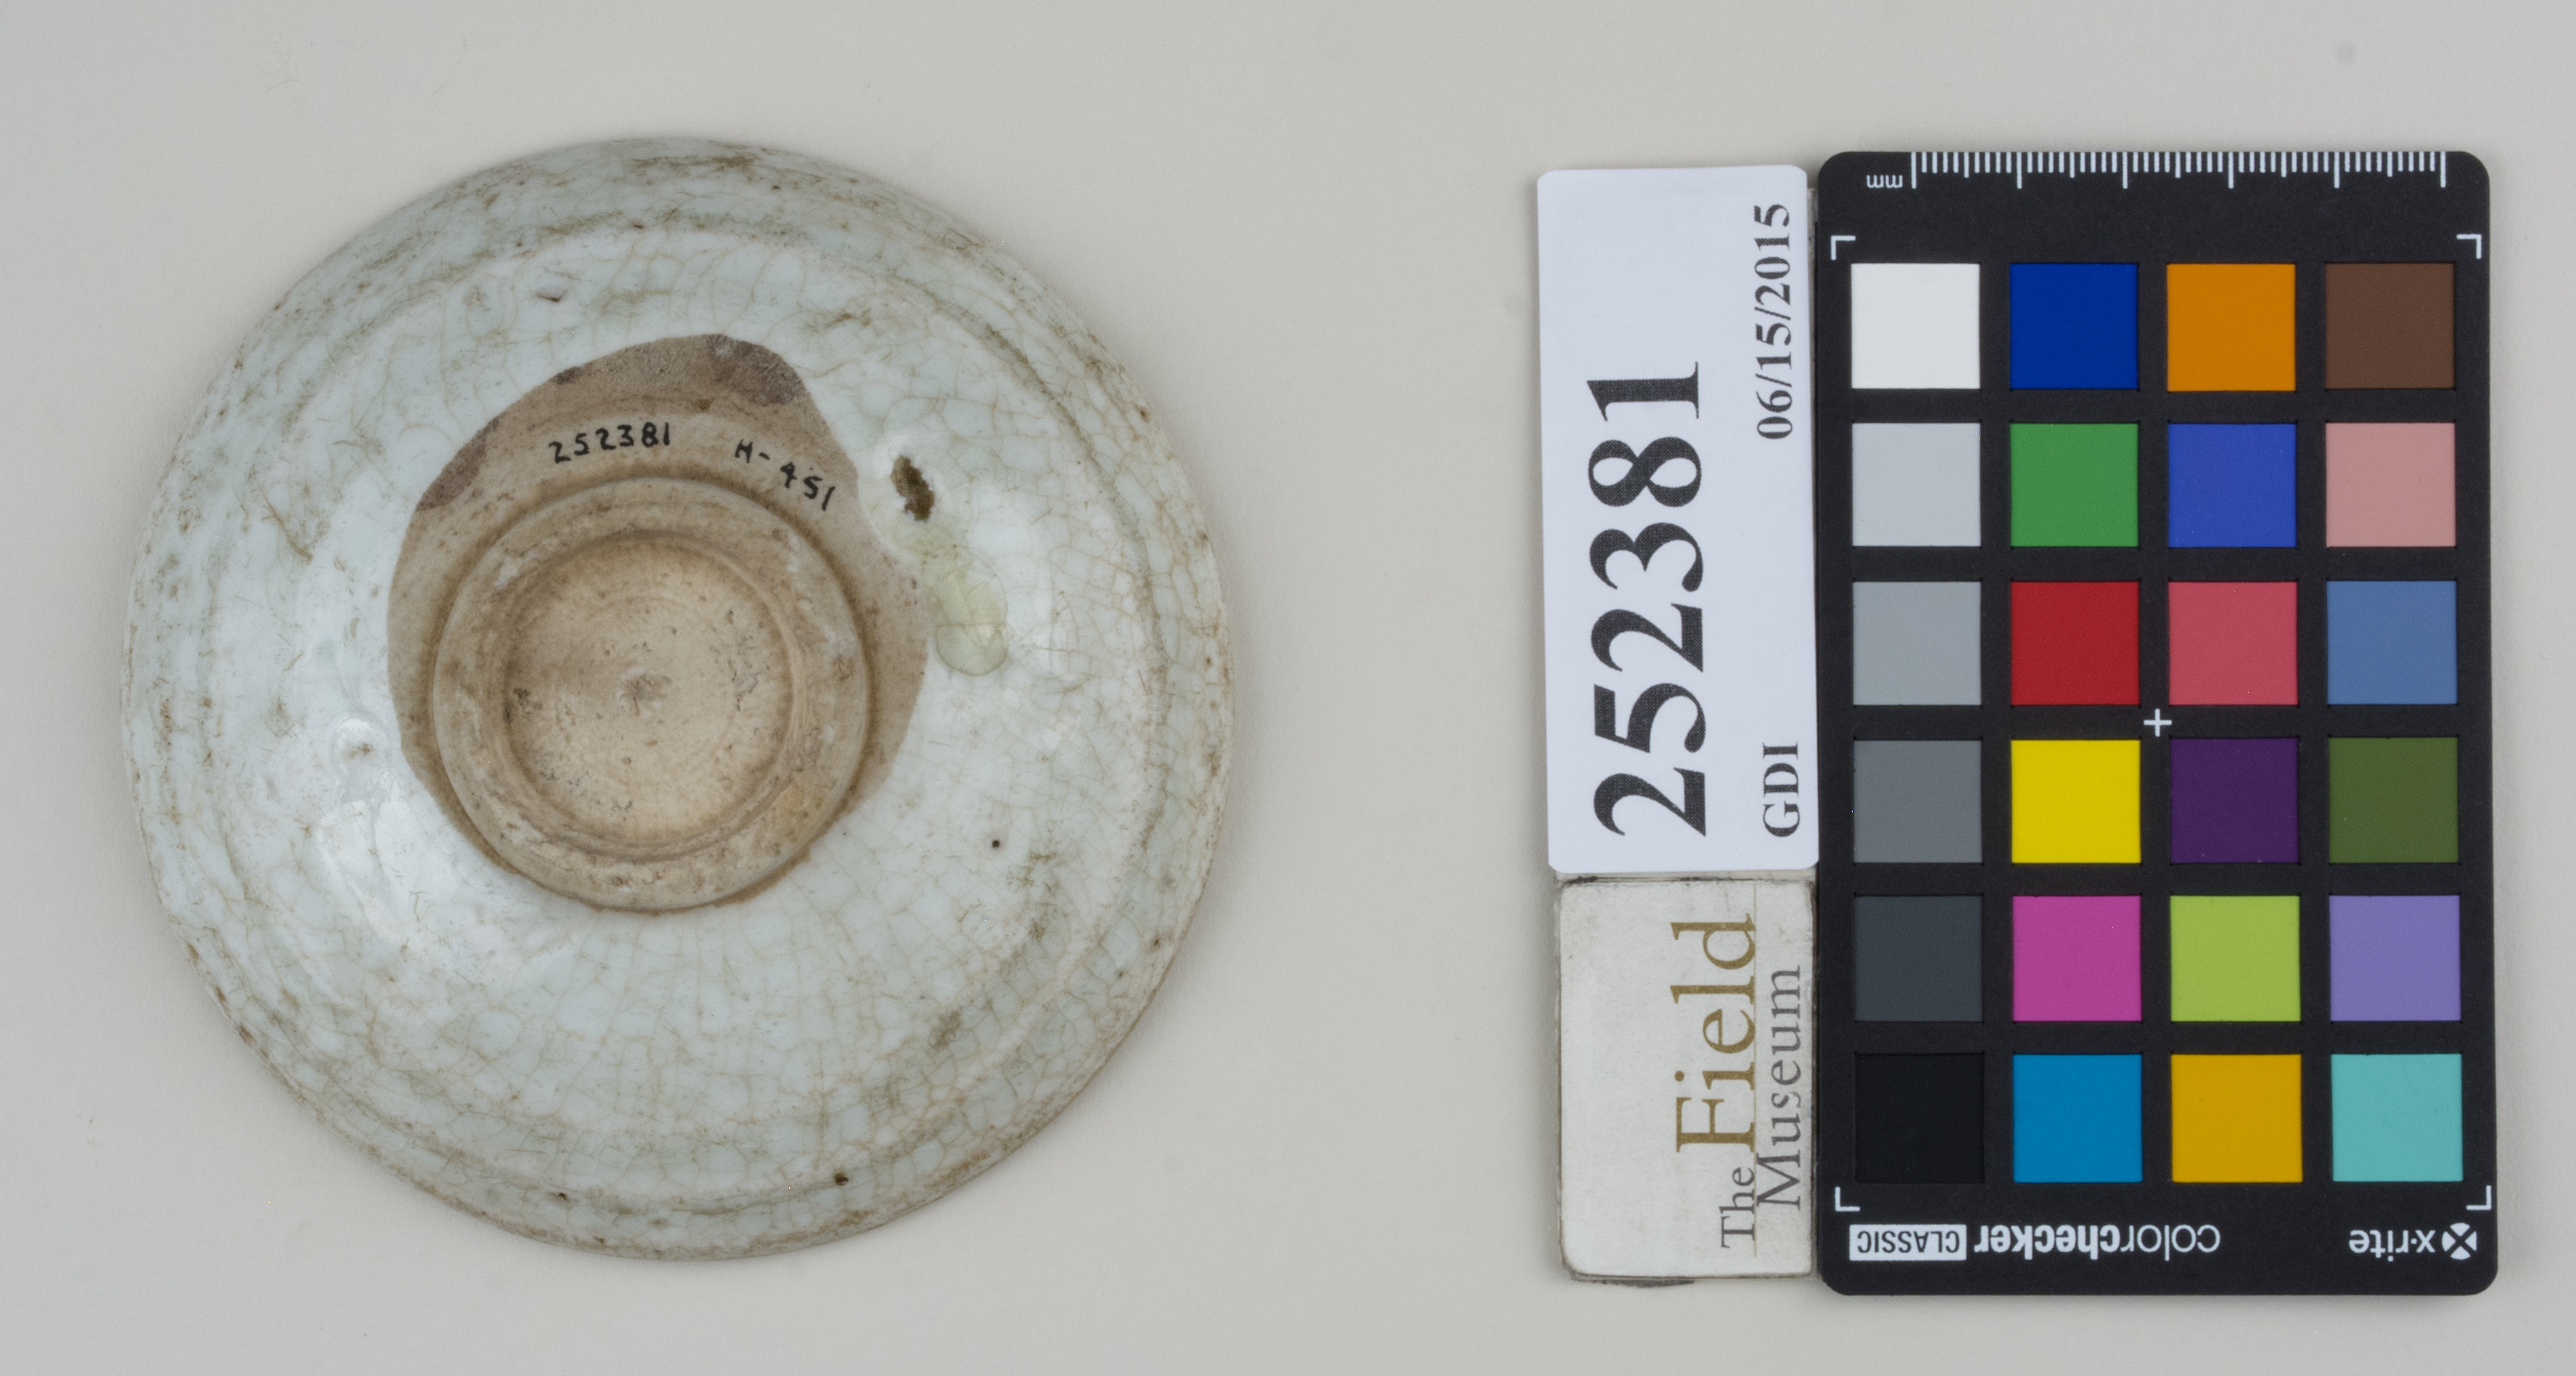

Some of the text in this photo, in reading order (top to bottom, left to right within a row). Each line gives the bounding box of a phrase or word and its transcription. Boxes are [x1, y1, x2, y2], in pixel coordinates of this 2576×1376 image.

[1866, 174, 1903, 189] mm
[1753, 203, 1793, 440] 06/15/2015
[548, 421, 836, 512] 252381 H-451
[1586, 360, 1707, 837] 252381
[1762, 741, 1801, 838] GDI
[1669, 913, 1756, 1249] The Field
[1756, 964, 1802, 1211] Museum
[1856, 1224, 2221, 1262] colorchecker CLASSIC
